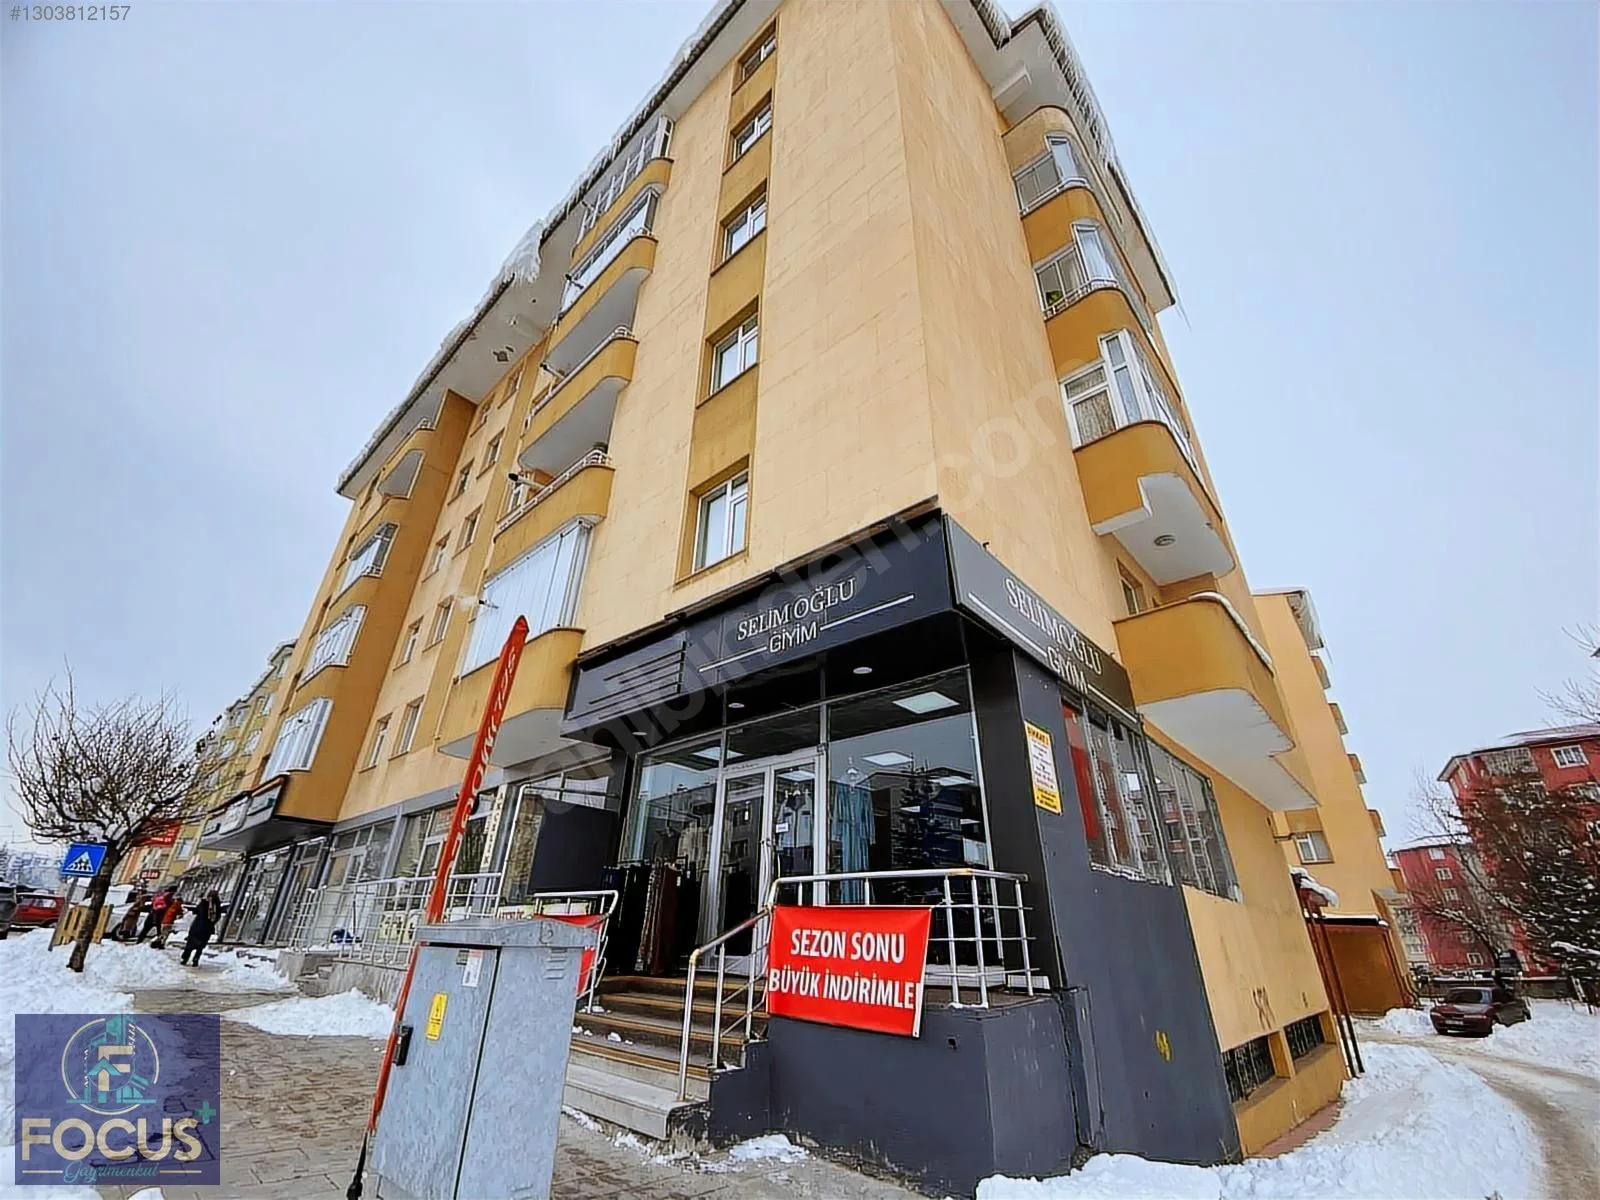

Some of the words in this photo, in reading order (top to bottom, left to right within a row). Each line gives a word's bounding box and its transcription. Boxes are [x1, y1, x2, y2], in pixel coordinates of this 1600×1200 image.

[793, 577, 856, 619] OĞLU
[769, 621, 817, 653] GİYİM
[790, 928, 846, 959] SEZON
[850, 931, 905, 964] SONU
[768, 964, 820, 998] BÜYÜK
[822, 968, 921, 1010] İNDİRİMLE
